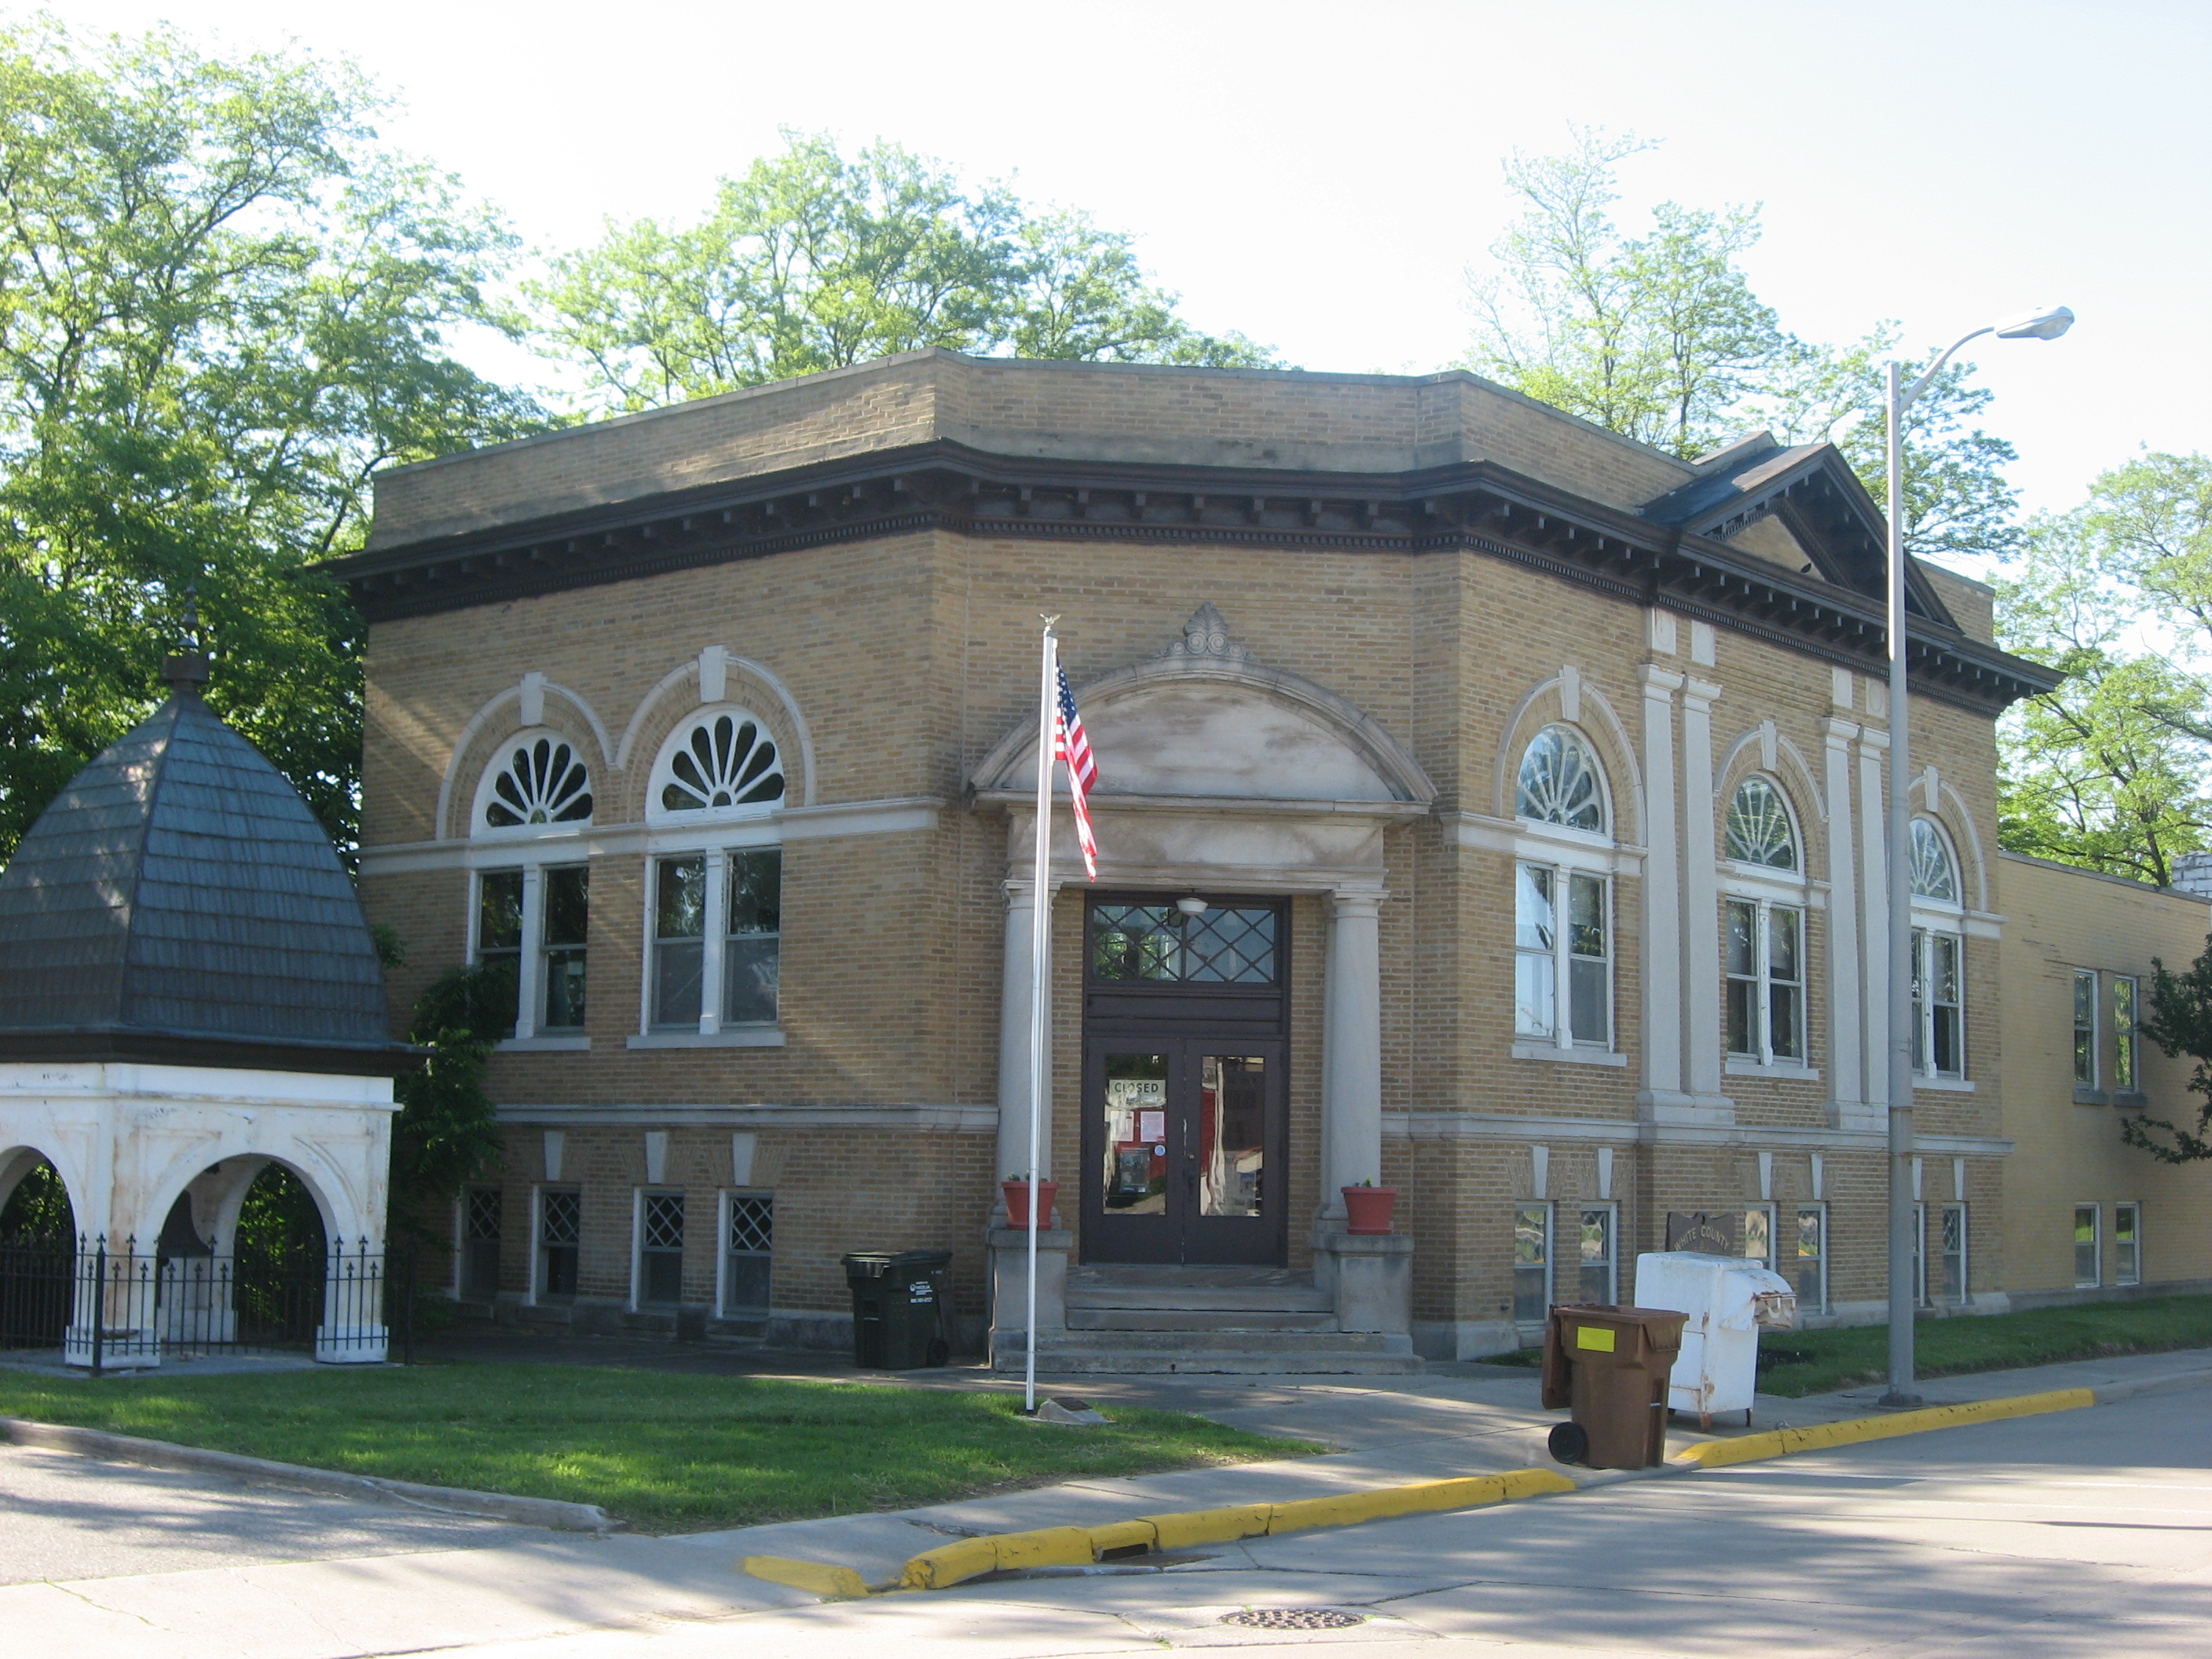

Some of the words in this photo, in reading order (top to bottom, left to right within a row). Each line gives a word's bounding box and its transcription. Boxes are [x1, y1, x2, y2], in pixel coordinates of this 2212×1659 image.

[1115, 1082, 1159, 1093] CLOSED
[1674, 1227, 1697, 1252] WHITE
[1701, 1225, 1730, 1251] COUNTY
